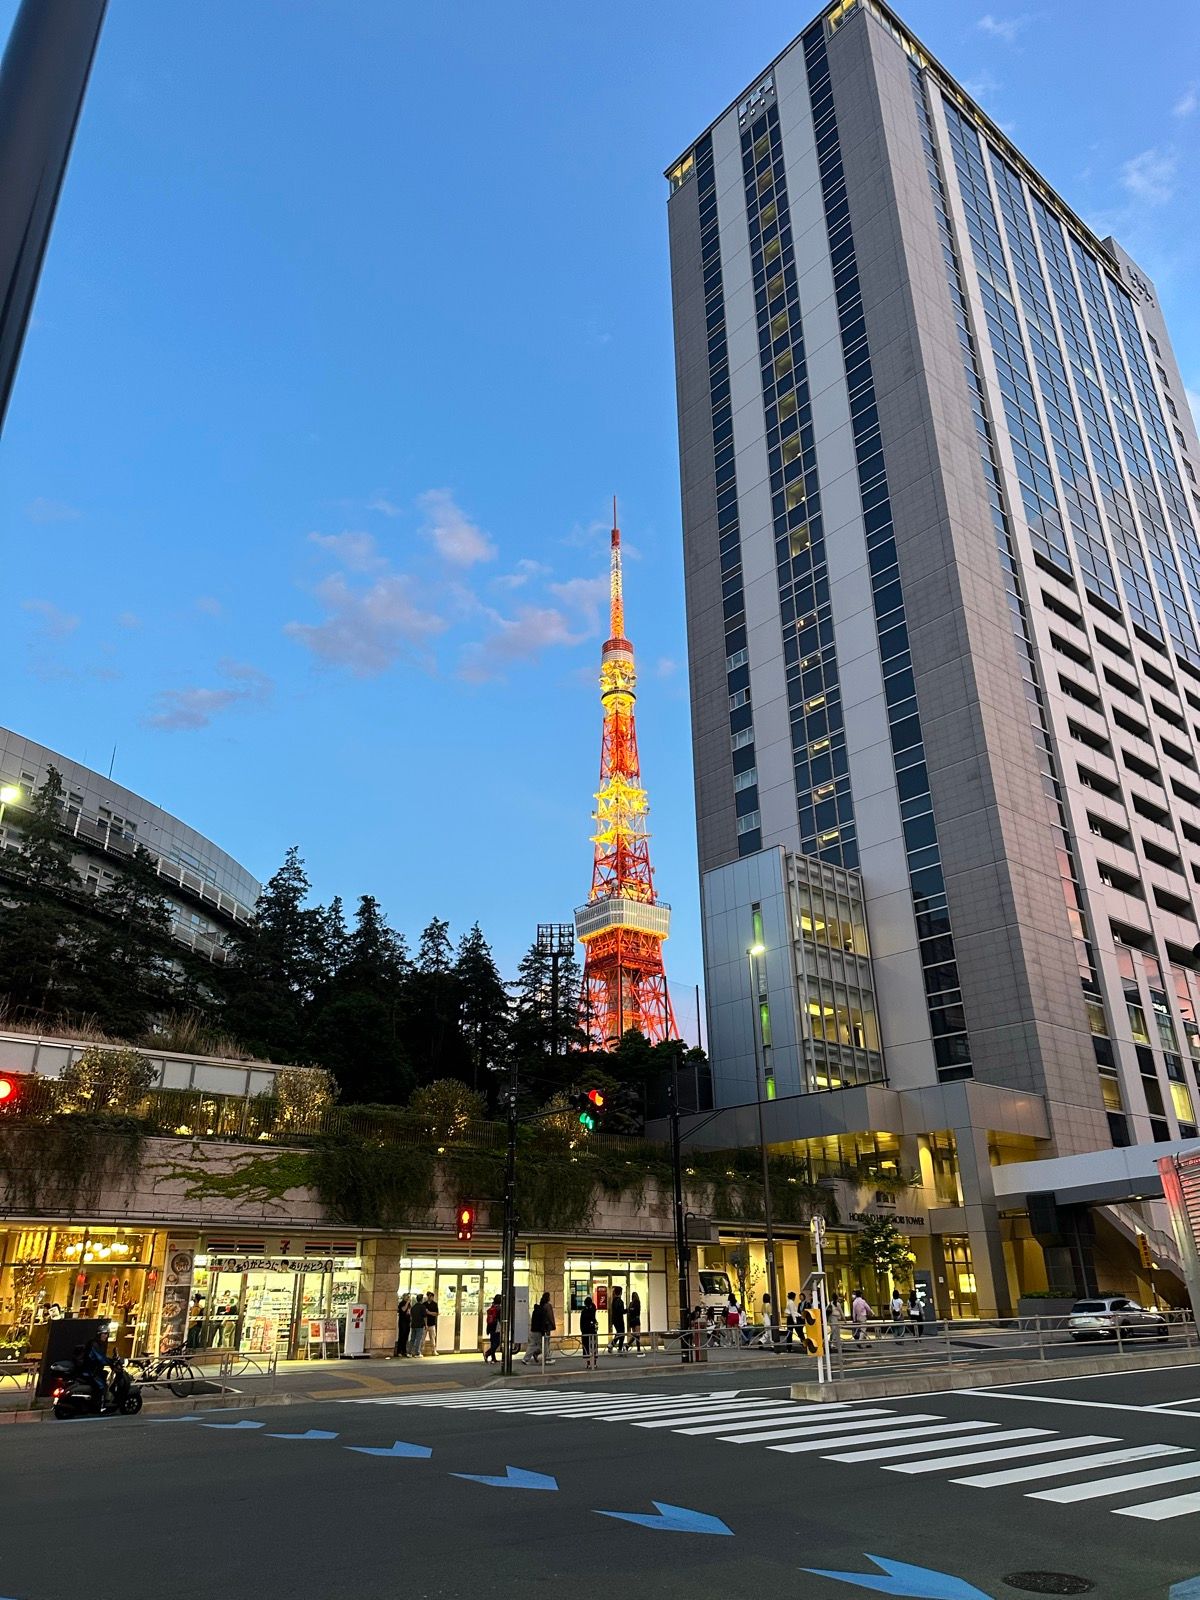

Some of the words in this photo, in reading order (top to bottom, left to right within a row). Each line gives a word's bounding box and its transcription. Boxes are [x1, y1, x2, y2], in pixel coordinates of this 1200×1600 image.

[740, 90, 774, 126] MORI
[905, 1215, 925, 1225] TOWER
[288, 1260, 323, 1272] ありがとう
